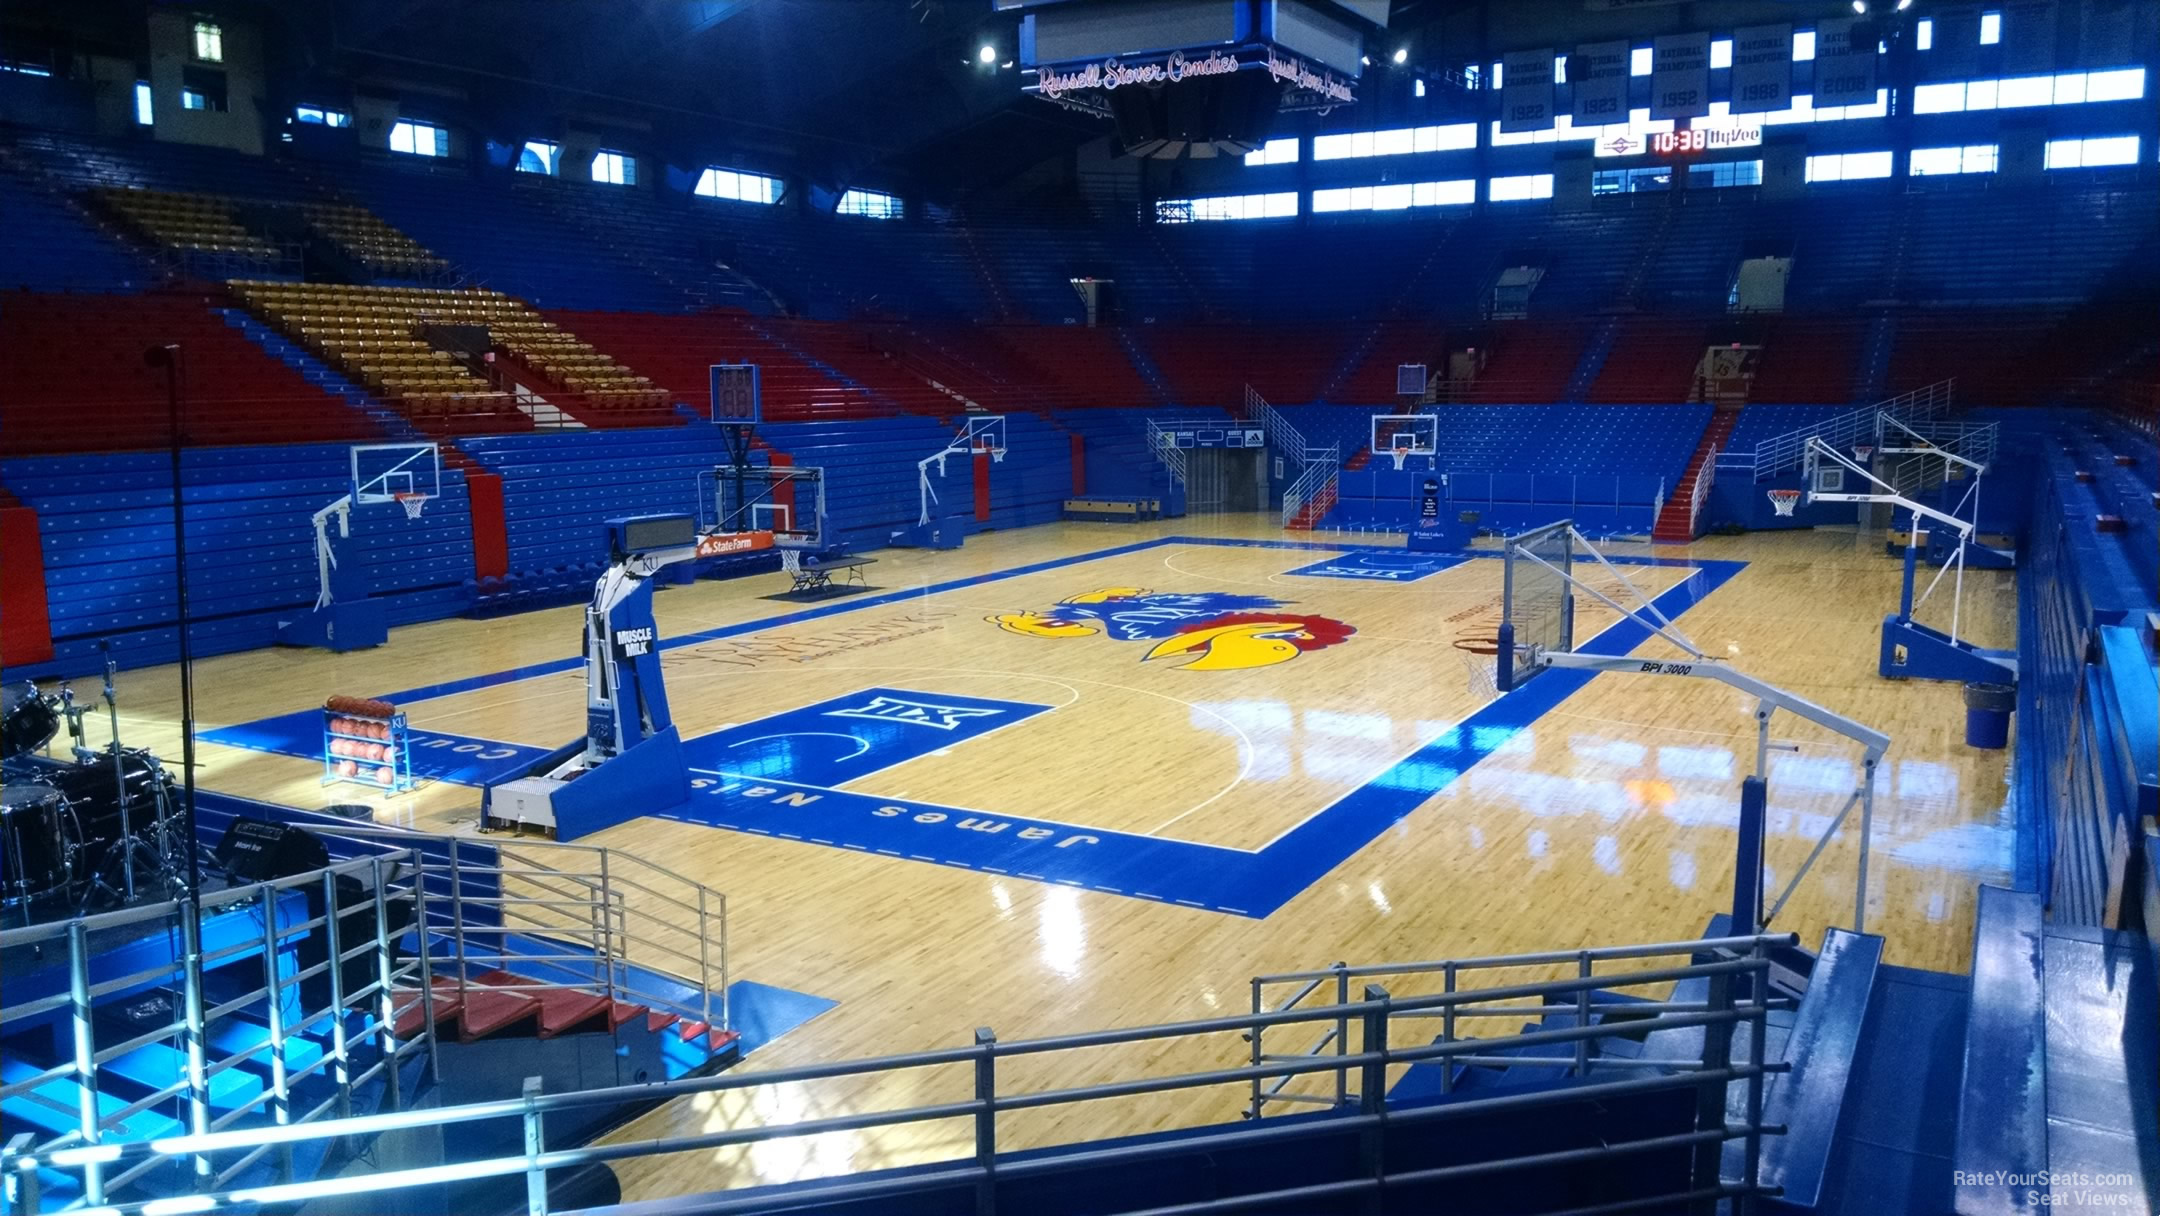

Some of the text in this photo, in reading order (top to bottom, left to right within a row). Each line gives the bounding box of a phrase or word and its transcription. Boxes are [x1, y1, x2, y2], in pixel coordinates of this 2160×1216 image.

[1659, 45, 1705, 59] NATIONAL
[1740, 38, 1785, 51] NATIONAL
[1037, 49, 1239, 99] Russell Stover Candies
[1742, 83, 1780, 101] 1988
[1823, 75, 1868, 95] 2008
[1582, 97, 1618, 115] 1923
[1661, 90, 1699, 108] 1952
[1511, 104, 1545, 121] 1922
[1654, 131, 1706, 152] 10:38
[642, 557, 658, 572] KU
[616, 628, 653, 645] MUSCLE
[625, 641, 648, 658] MILK
[1640, 662, 1692, 675] BPI 3000
[391, 716, 406, 729] KU
[871, 805, 1100, 848] James
